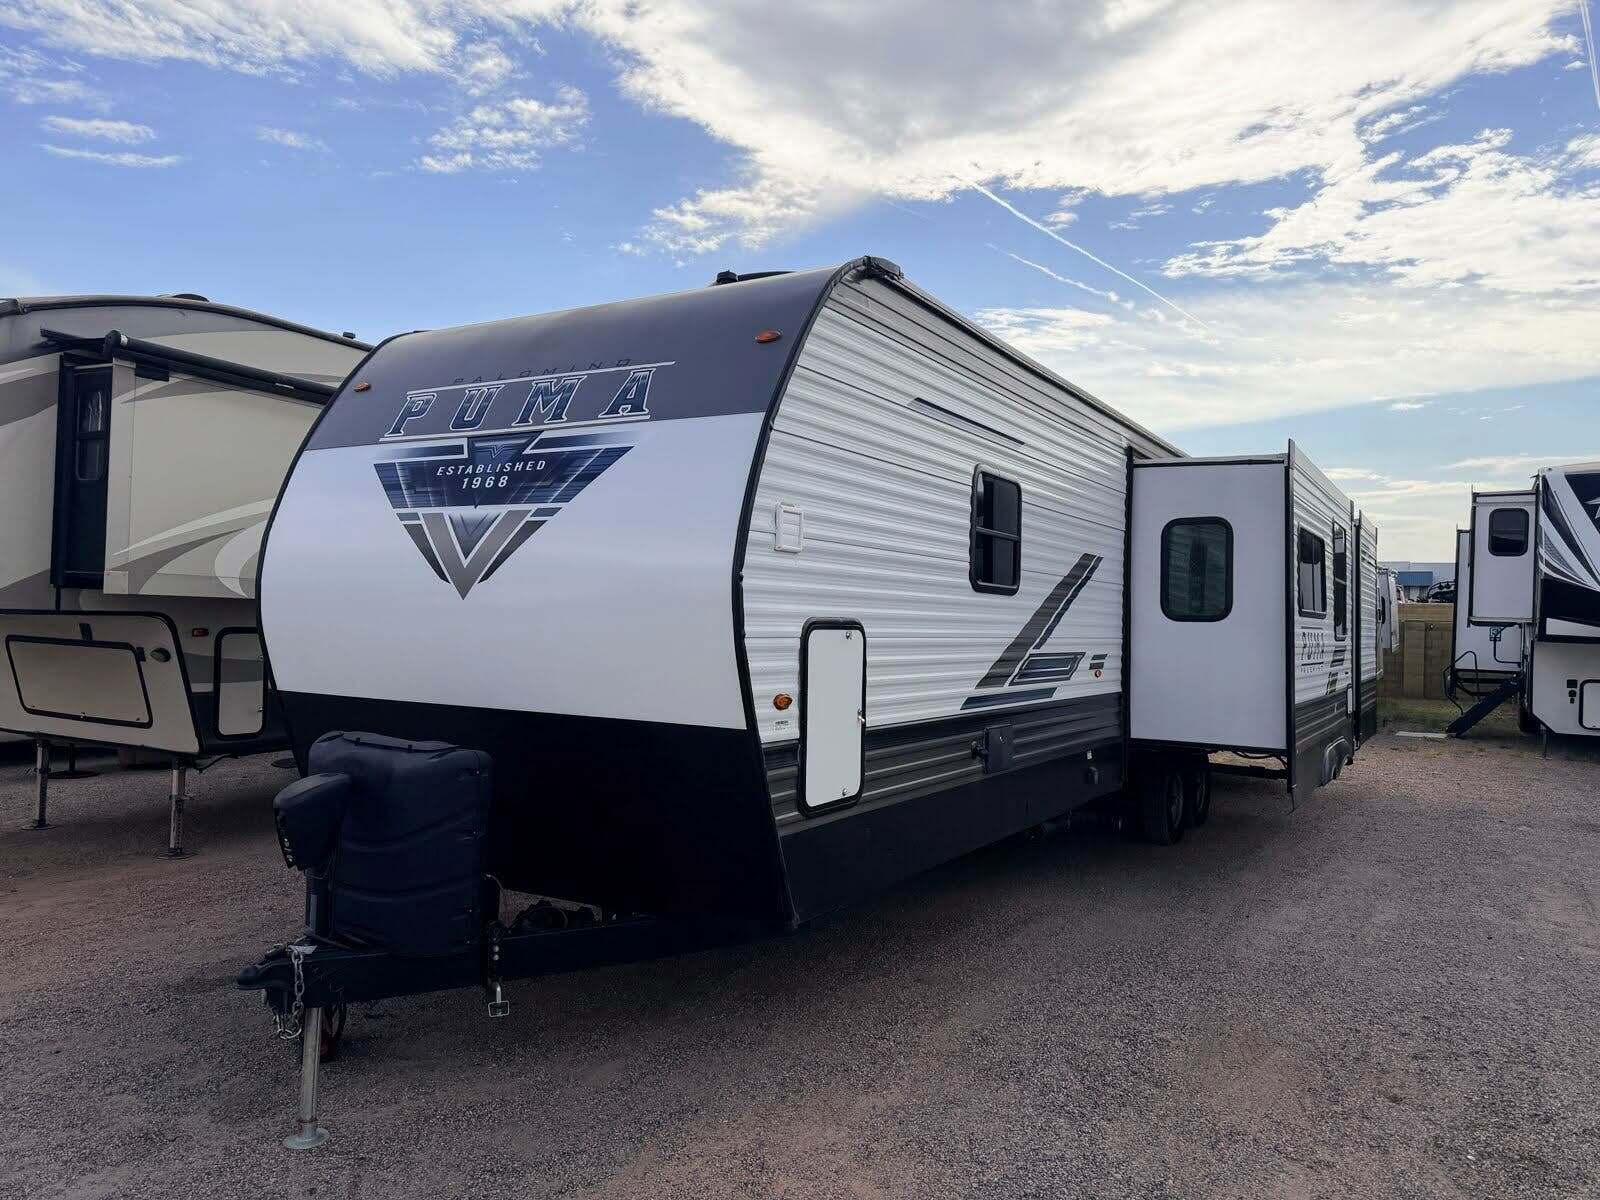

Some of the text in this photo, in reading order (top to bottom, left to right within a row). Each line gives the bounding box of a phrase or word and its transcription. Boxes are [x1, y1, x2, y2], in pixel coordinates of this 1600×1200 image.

[453, 358, 632, 385] PALOMINO
[384, 367, 656, 438] PUMA
[436, 460, 547, 477] ESTABLISHED
[461, 475, 509, 490] 1968
[1300, 632, 1324, 660] PUMA
